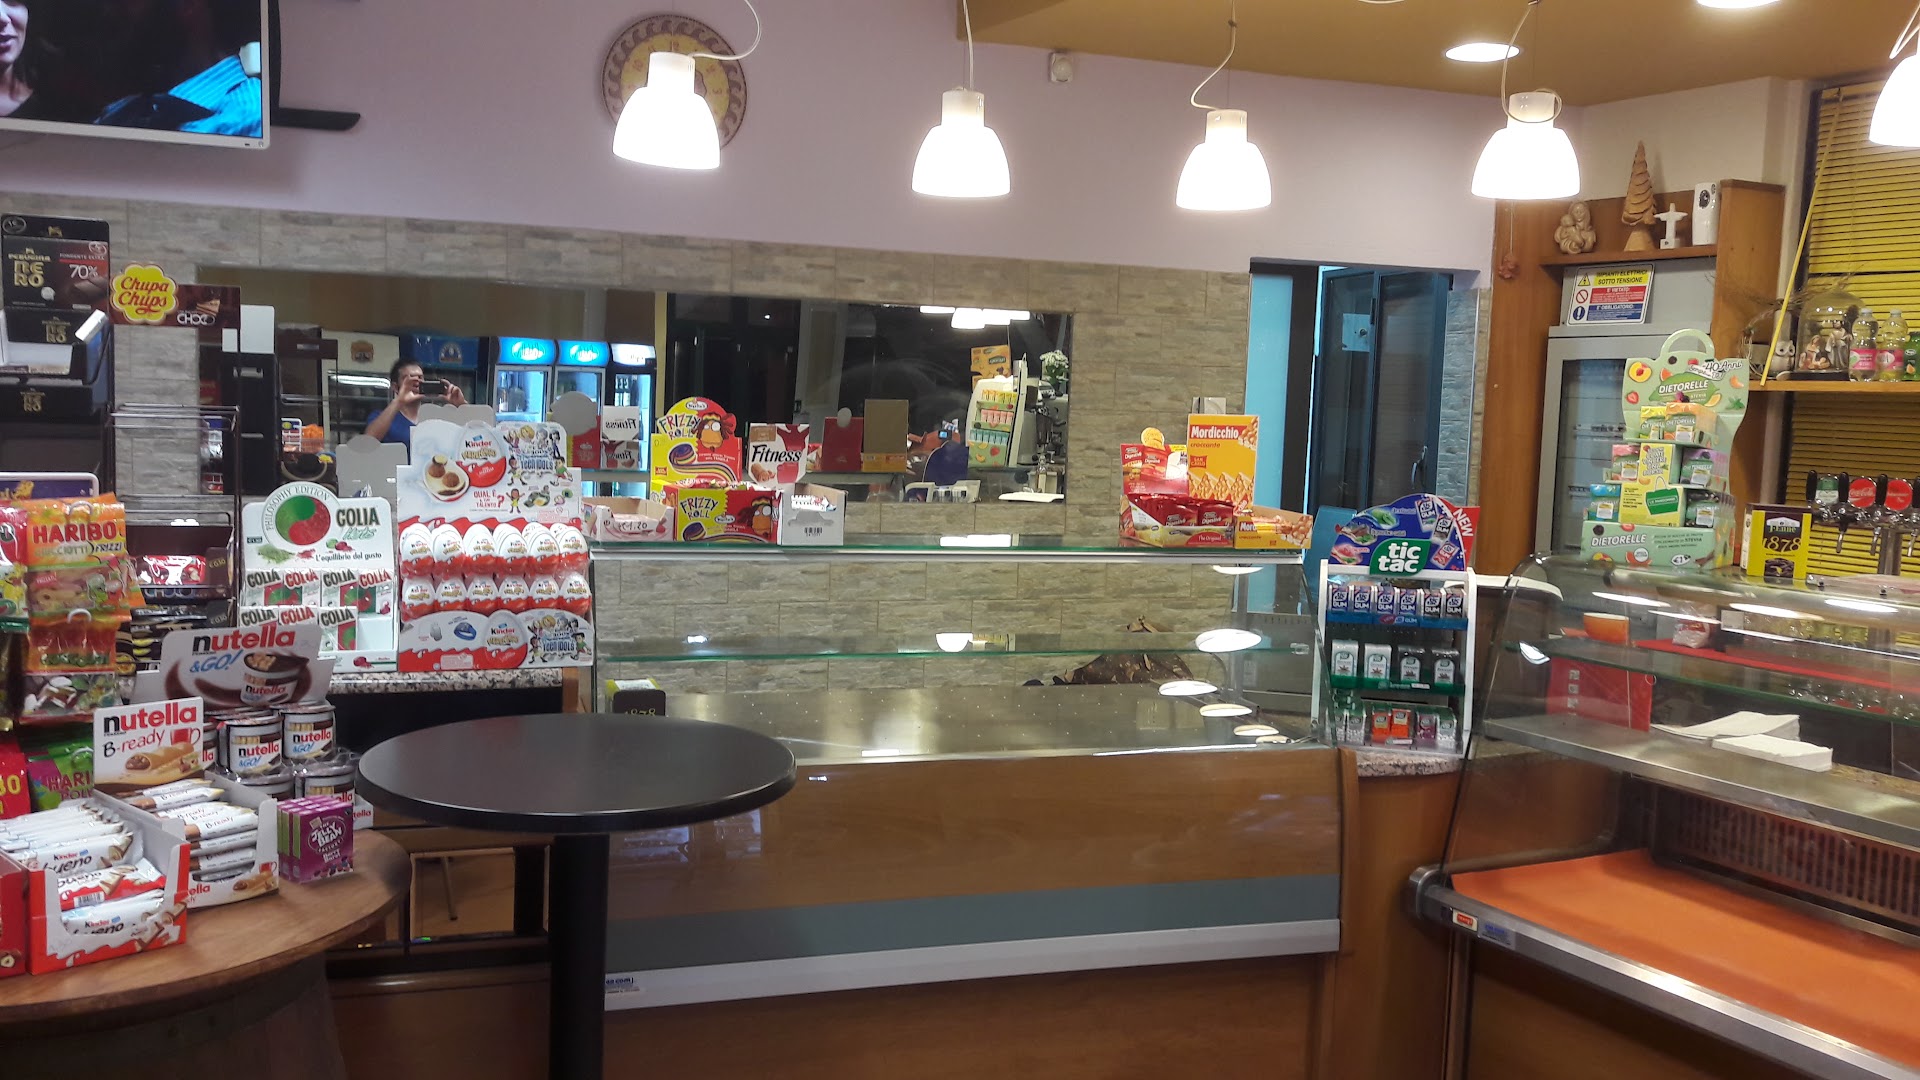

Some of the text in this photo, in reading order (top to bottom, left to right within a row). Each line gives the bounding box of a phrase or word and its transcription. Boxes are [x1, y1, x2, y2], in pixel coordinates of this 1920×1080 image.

[69, 264, 98, 280] 70%
[120, 277, 169, 294] Chupa
[118, 291, 167, 311] Chups
[1659, 380, 1709, 394] DIETORELLE
[659, 413, 700, 433] FRIZZY
[668, 428, 693, 440] ROLL
[1191, 425, 1239, 439] Mordicchio
[465, 440, 492, 448] Kinder
[752, 444, 802, 462] Fitness
[680, 496, 719, 514] FRIZZY
[688, 510, 710, 520] ROLL
[1453, 508, 1474, 537] NEW
[33, 521, 117, 544] HARIBO
[1591, 534, 1647, 547] DIETORELLE
[1388, 542, 1422, 560] tic
[1763, 535, 1802, 552] 1878
[1378, 555, 1419, 573] tac
[192, 623, 296, 652] nutella
[189, 649, 244, 673] &GO!
[245, 684, 287, 695] nutella
[104, 702, 197, 733] nutella
[103, 728, 165, 758] B-ready
[292, 730, 332, 743] nutella
[238, 742, 280, 757] nutella
[318, 826, 342, 847] BEAN
[53, 853, 78, 861] Kinder
